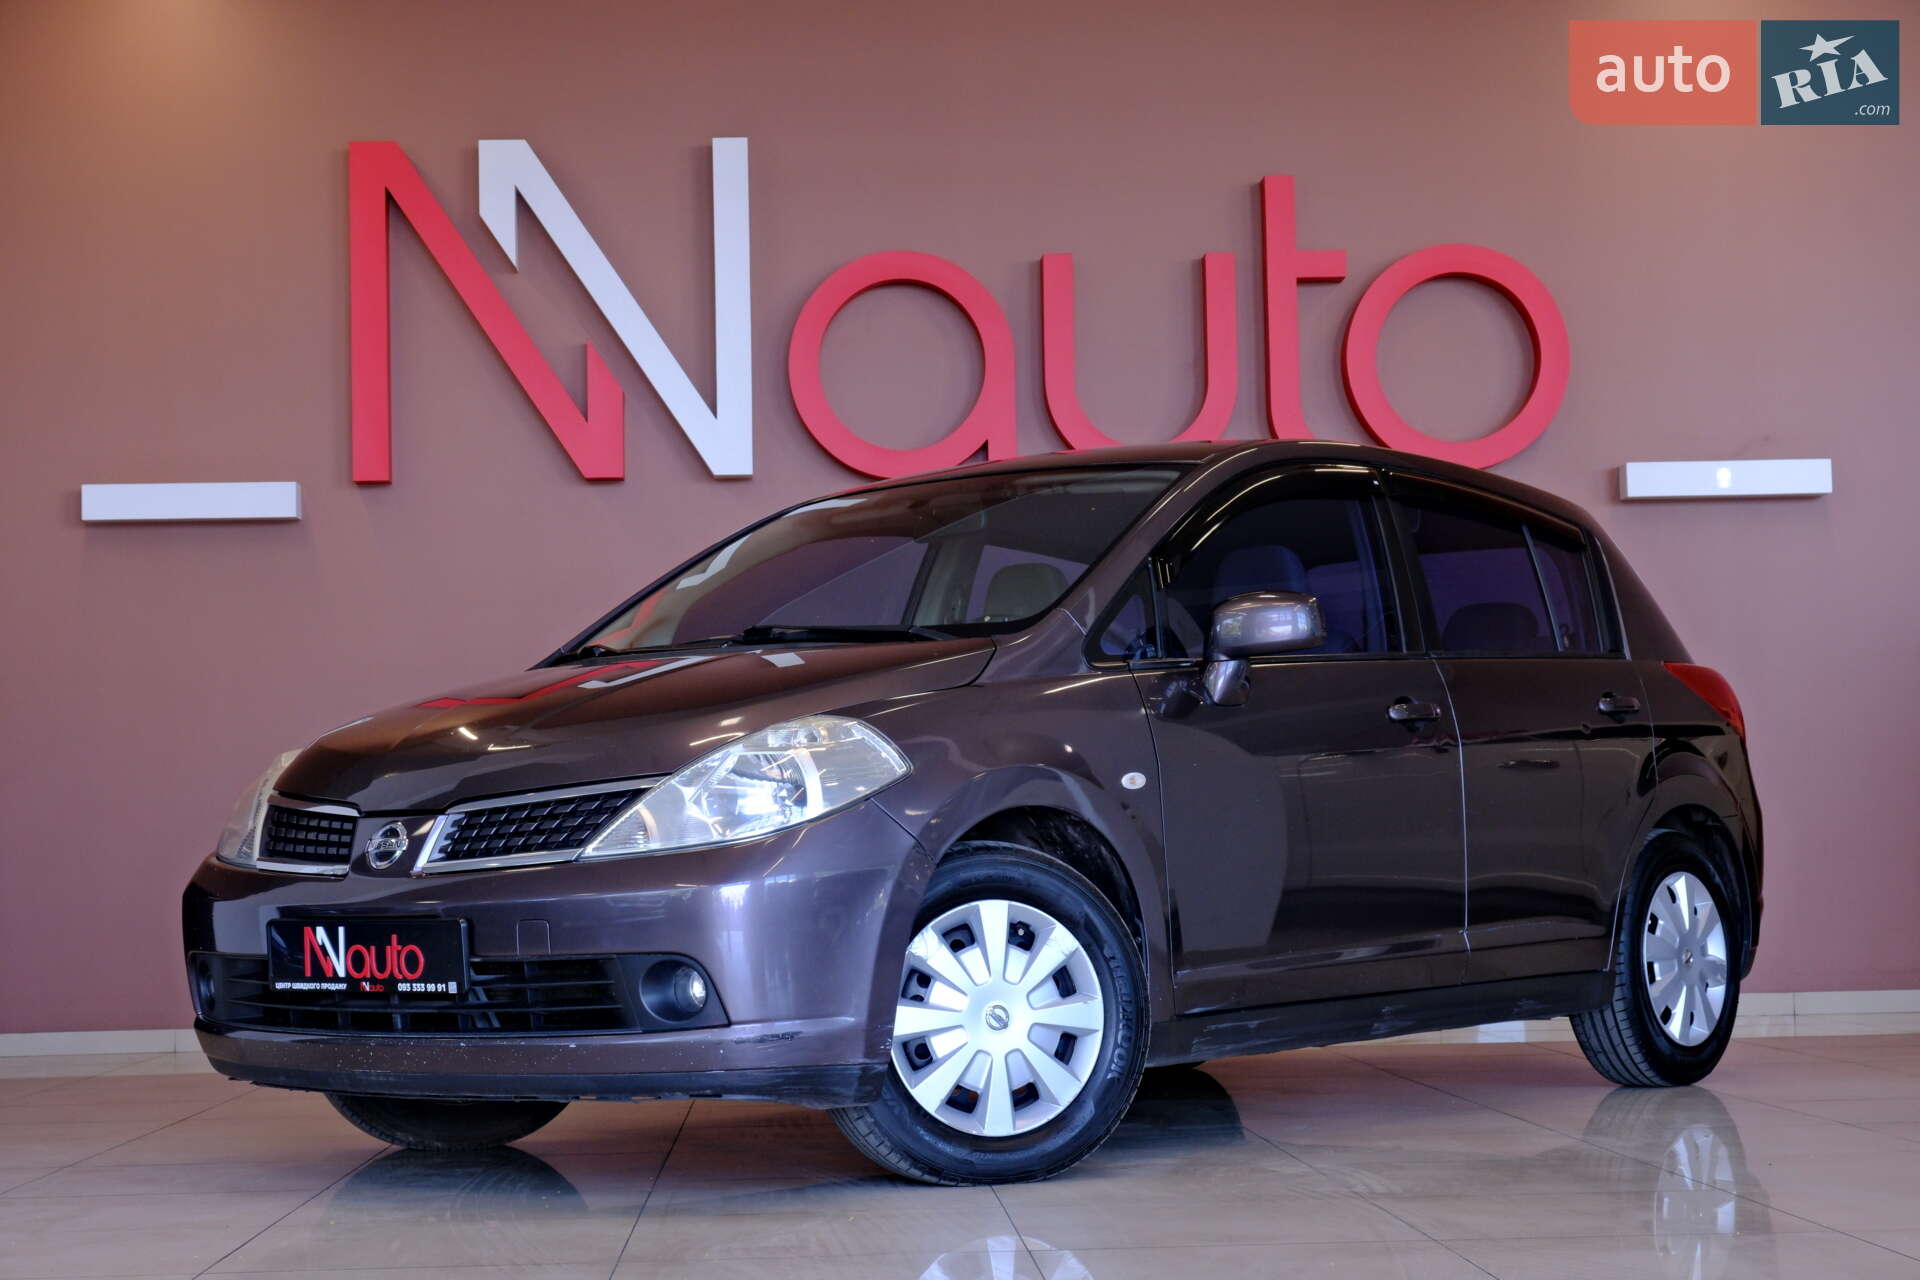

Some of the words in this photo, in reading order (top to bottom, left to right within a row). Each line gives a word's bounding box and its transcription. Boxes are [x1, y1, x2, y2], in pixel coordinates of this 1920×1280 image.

[347, 136, 1571, 482] NNauto
[303, 926, 425, 980] NNauto
[397, 982, 411, 992] 093
[427, 983, 436, 992] 99
[437, 983, 446, 992] 91
